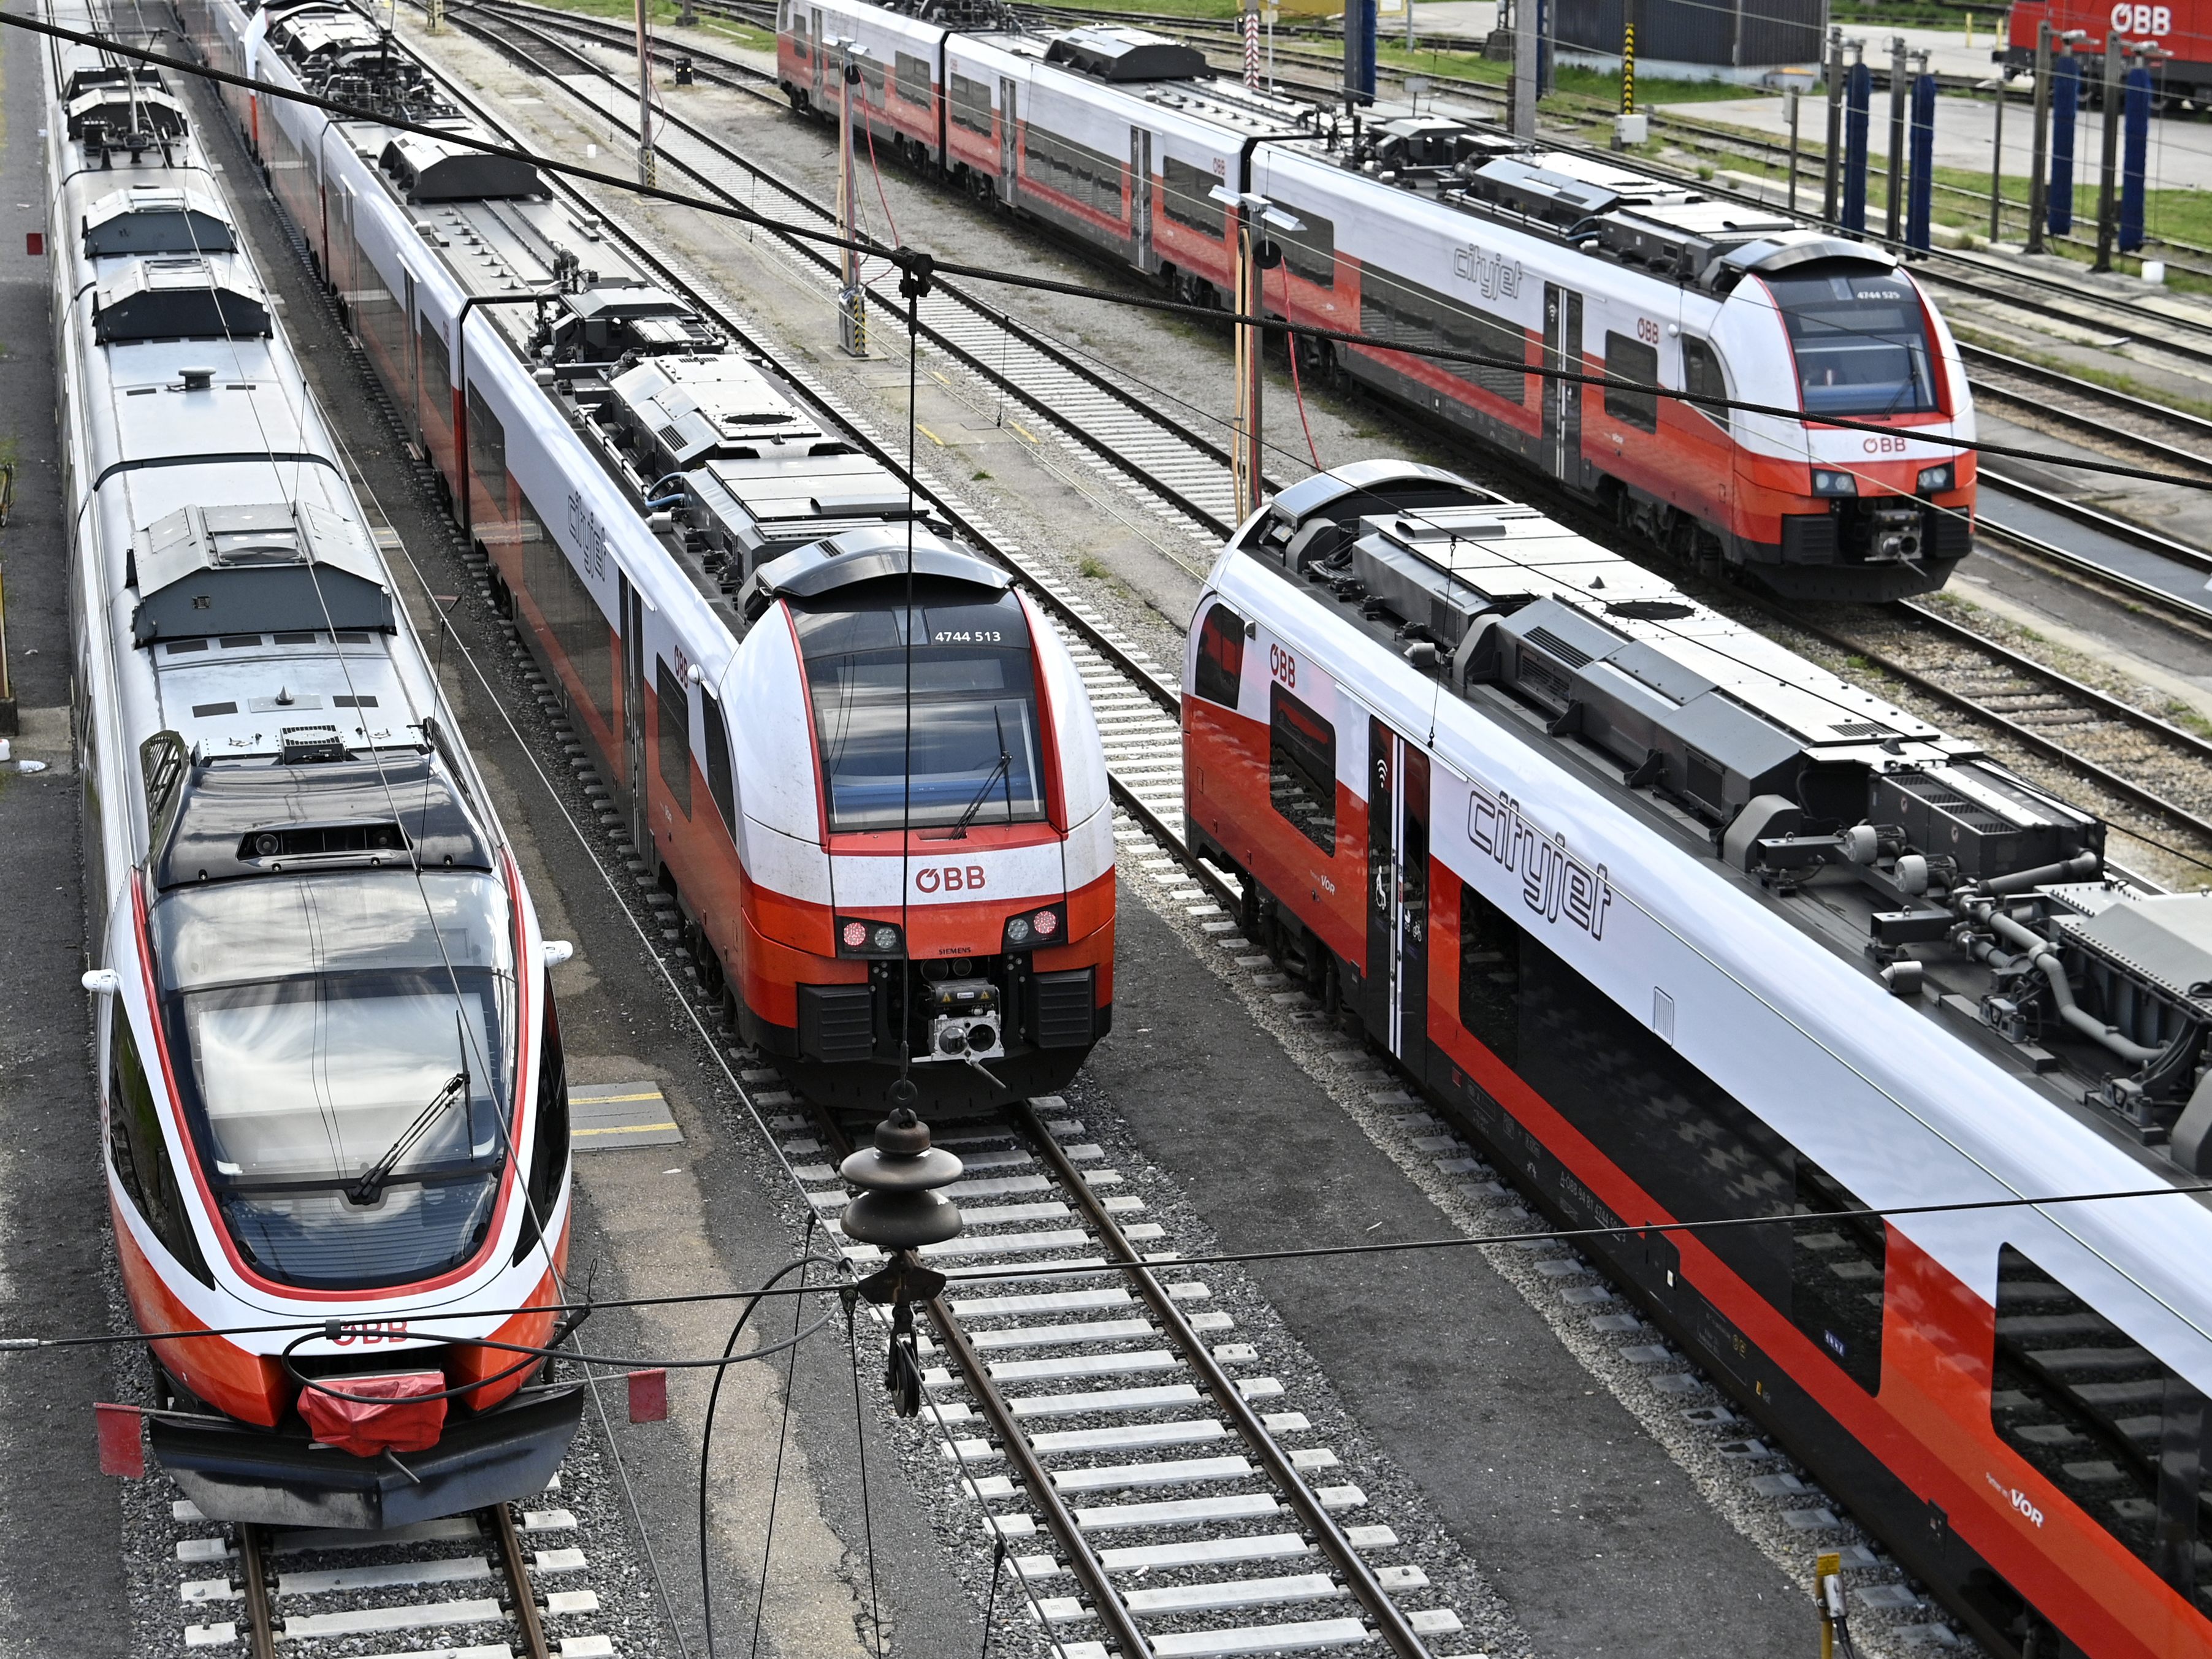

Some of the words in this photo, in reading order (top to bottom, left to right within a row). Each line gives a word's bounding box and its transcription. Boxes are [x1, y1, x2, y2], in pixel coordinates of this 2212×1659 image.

[2111, 2, 2171, 36] ÖBB
[1454, 243, 1522, 300] cityjet
[1638, 317, 1658, 344] ÖBB
[1863, 437, 1905, 453] ÖBB
[568, 490, 606, 582] cityjet
[935, 631, 971, 642] 4744
[975, 631, 1001, 642] 513
[674, 644, 688, 689] ÖBB
[1270, 643, 1295, 688] ÖBB
[916, 866, 985, 893] ÖBB
[1468, 790, 1611, 941] cityjet
[1321, 875, 1335, 896] VOR
[939, 947, 971, 955] SIEMENS
[2011, 1488, 2044, 1528] VOR
